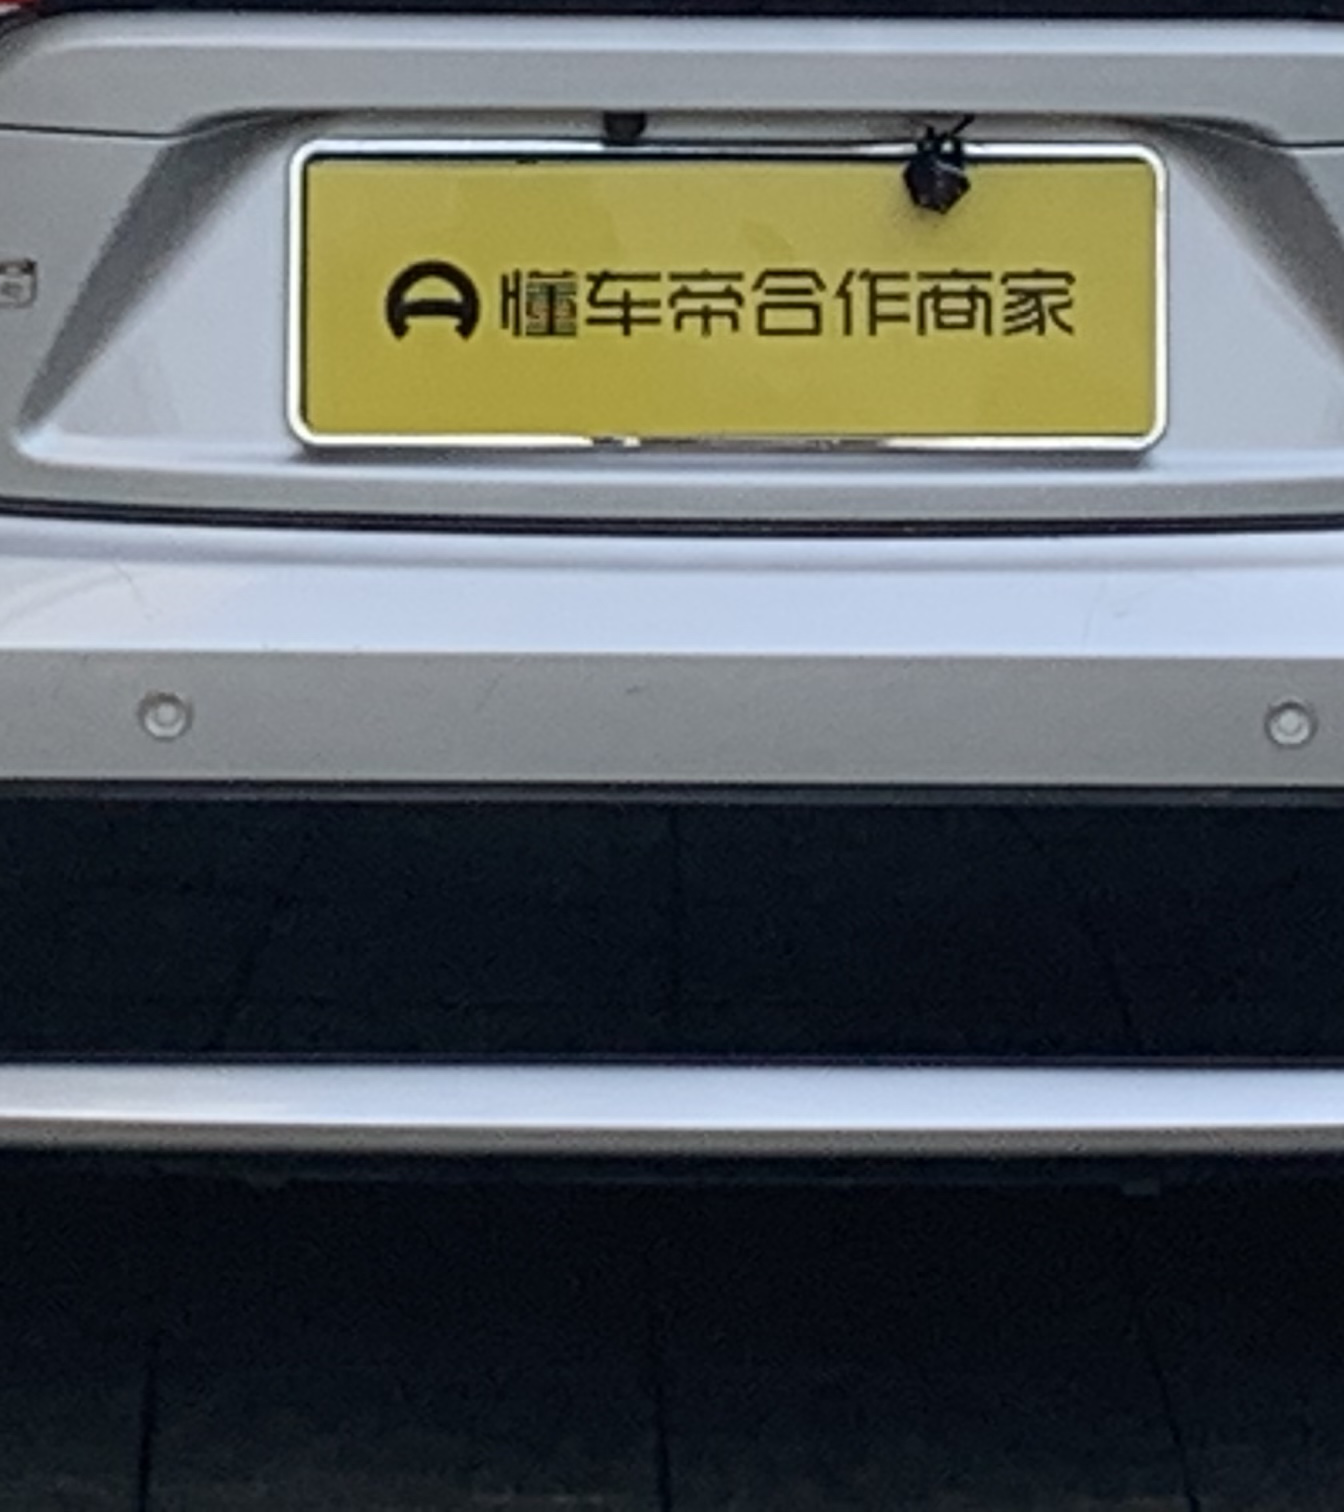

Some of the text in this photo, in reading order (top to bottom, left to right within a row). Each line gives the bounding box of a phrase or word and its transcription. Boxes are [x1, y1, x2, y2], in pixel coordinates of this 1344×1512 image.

[500, 268, 1076, 338] 懂车帝合作商家
